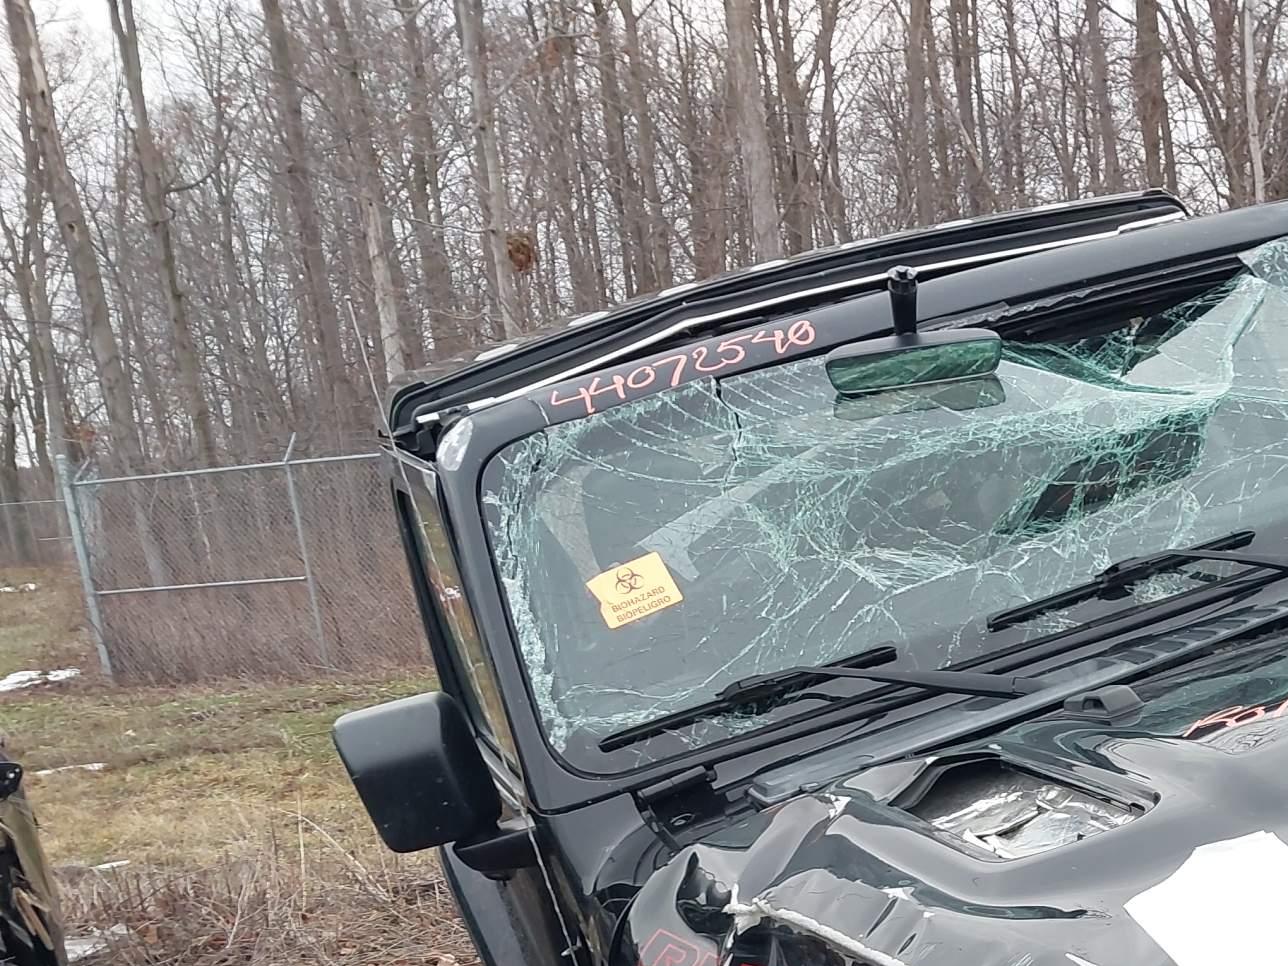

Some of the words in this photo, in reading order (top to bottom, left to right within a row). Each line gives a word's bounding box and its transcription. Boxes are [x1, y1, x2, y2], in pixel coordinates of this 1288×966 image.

[551, 320, 815, 414] 44072540
[611, 586, 665, 613] BIOHAZARD
[616, 595, 671, 623] BIOPELIGRO
